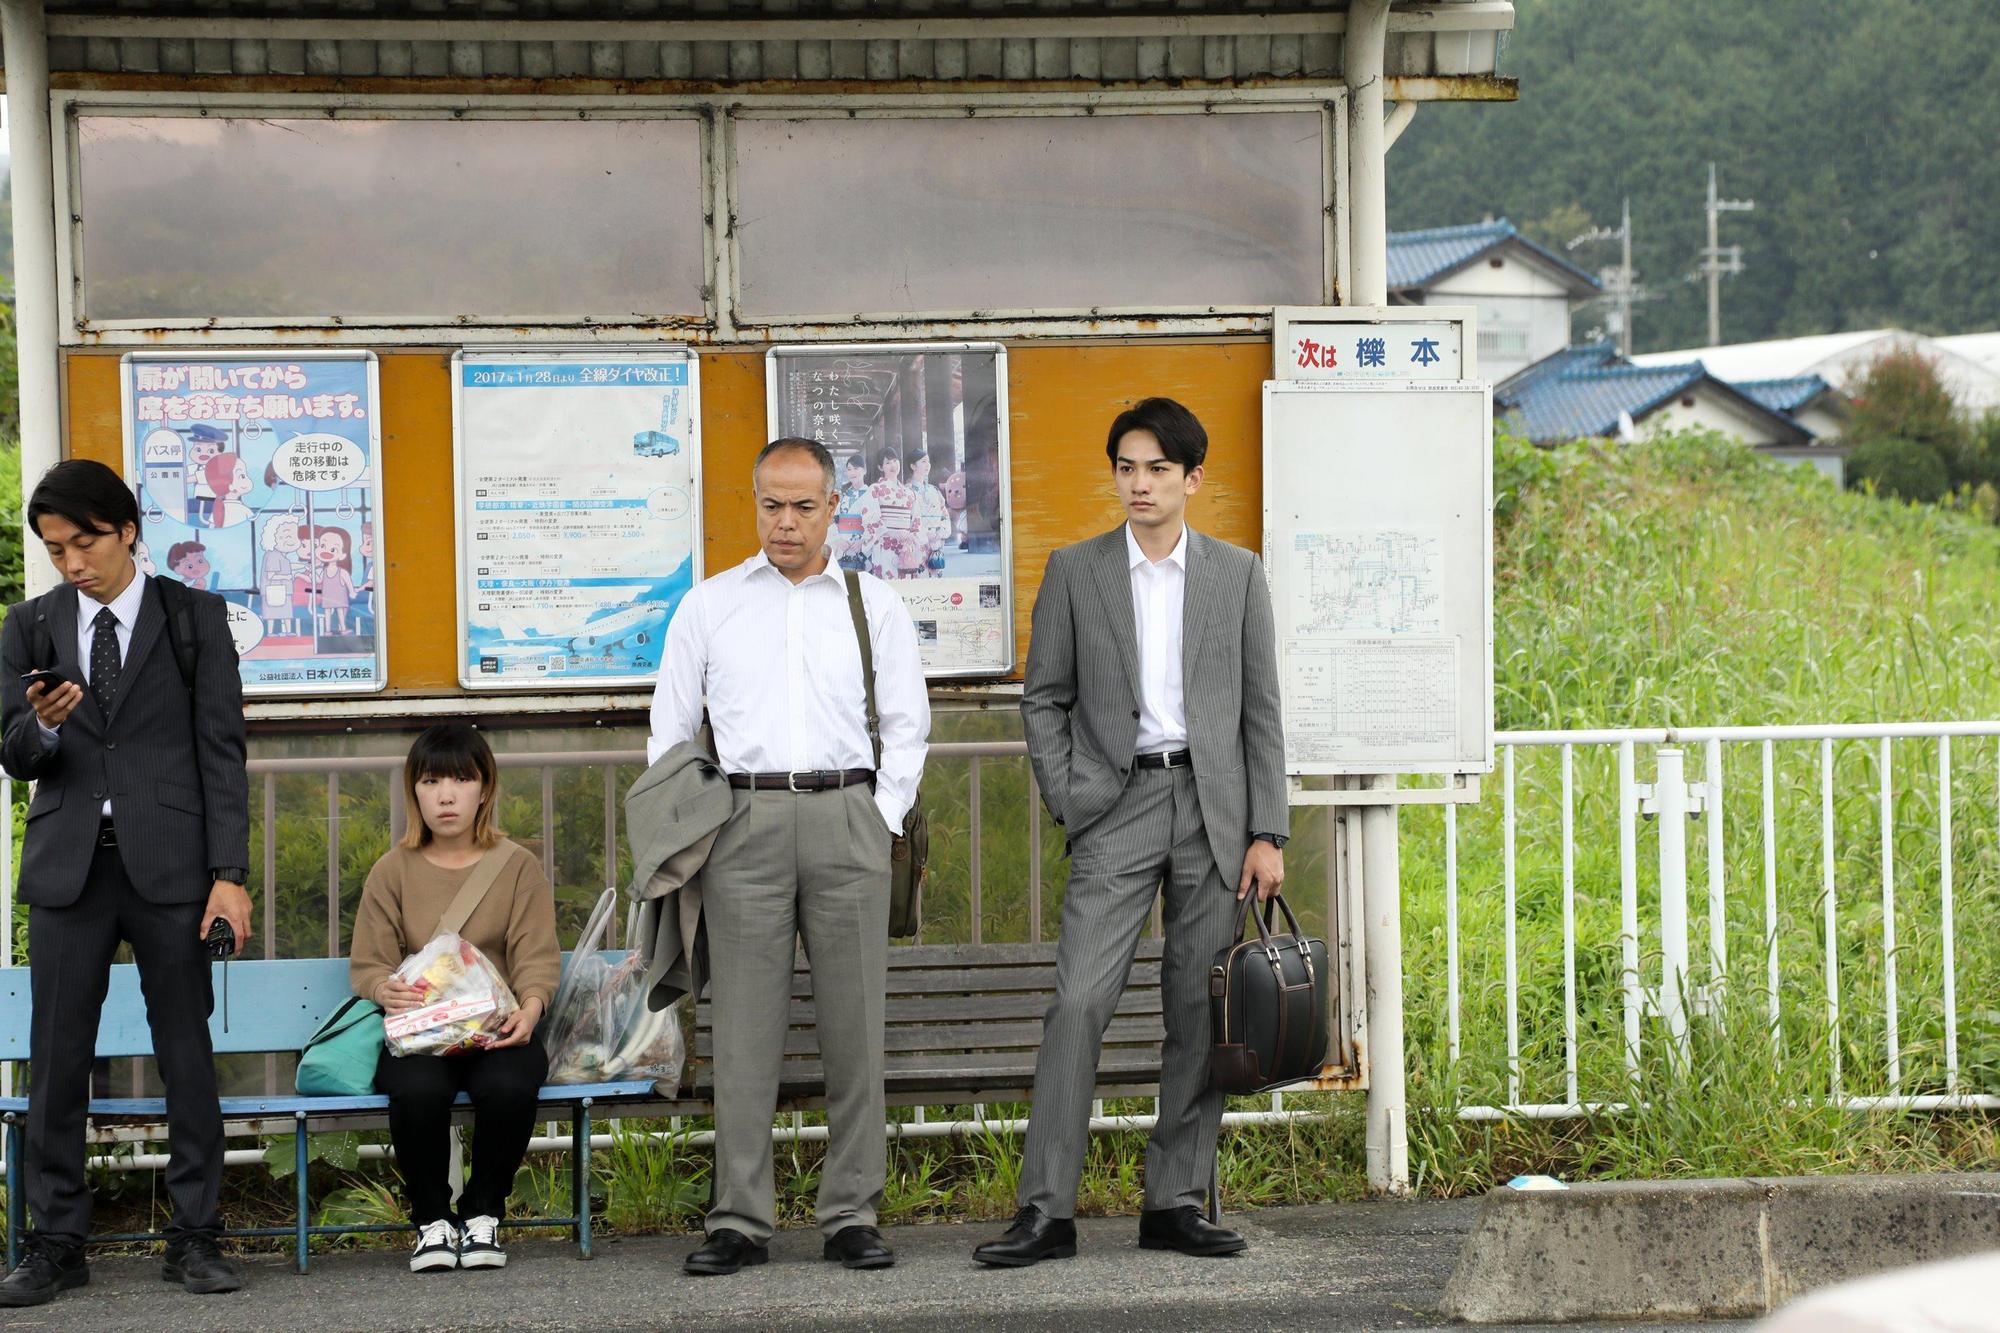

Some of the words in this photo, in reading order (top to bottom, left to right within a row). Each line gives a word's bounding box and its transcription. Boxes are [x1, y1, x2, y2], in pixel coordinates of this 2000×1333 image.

[1297, 338, 1337, 368] 次は
[136, 365, 307, 391] 扉が開いてから
[138, 393, 367, 420] 席をお立ち願います。
[146, 445, 182, 456] バス停
[294, 441, 343, 453] 走行中の
[289, 456, 349, 468] 席の移動は
[292, 470, 347, 481] 危険です。
[259, 672, 304, 681] 公益社団法人
[306, 667, 372, 680] 日本バス協会
